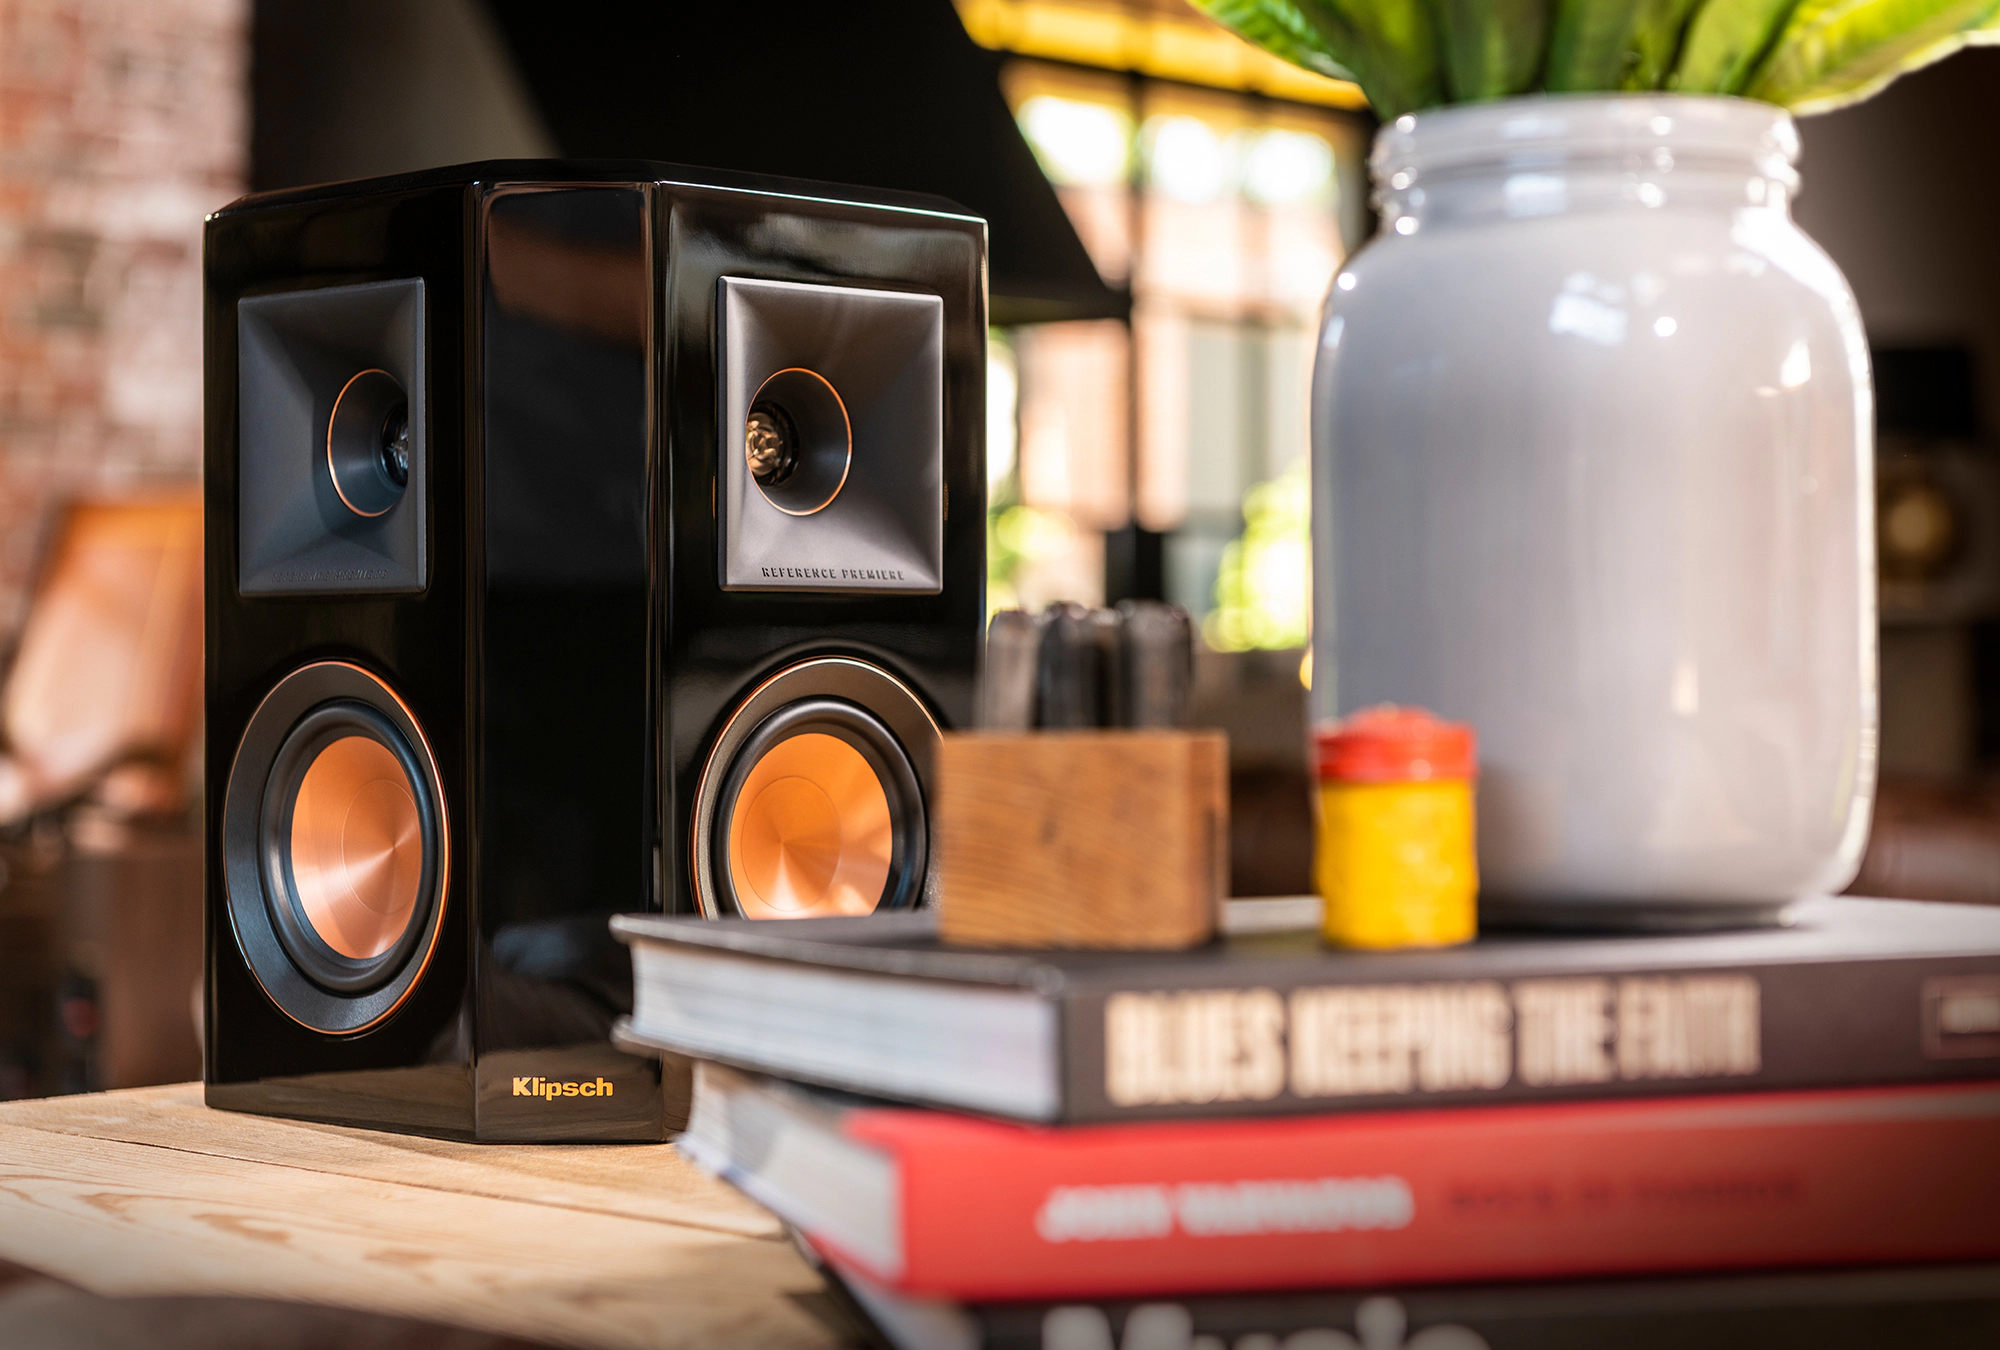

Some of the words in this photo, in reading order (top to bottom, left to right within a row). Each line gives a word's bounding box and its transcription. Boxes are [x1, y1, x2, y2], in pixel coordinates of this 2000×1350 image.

[761, 567, 837, 579] REFERENCE
[841, 569, 905, 581] PREMIERE
[1105, 986, 1286, 1106] BLUES
[1289, 978, 1514, 1098] KEEPING
[1515, 974, 1617, 1088] THE
[1617, 973, 1761, 1082] FAITH
[512, 1076, 614, 1102] Klipsch
